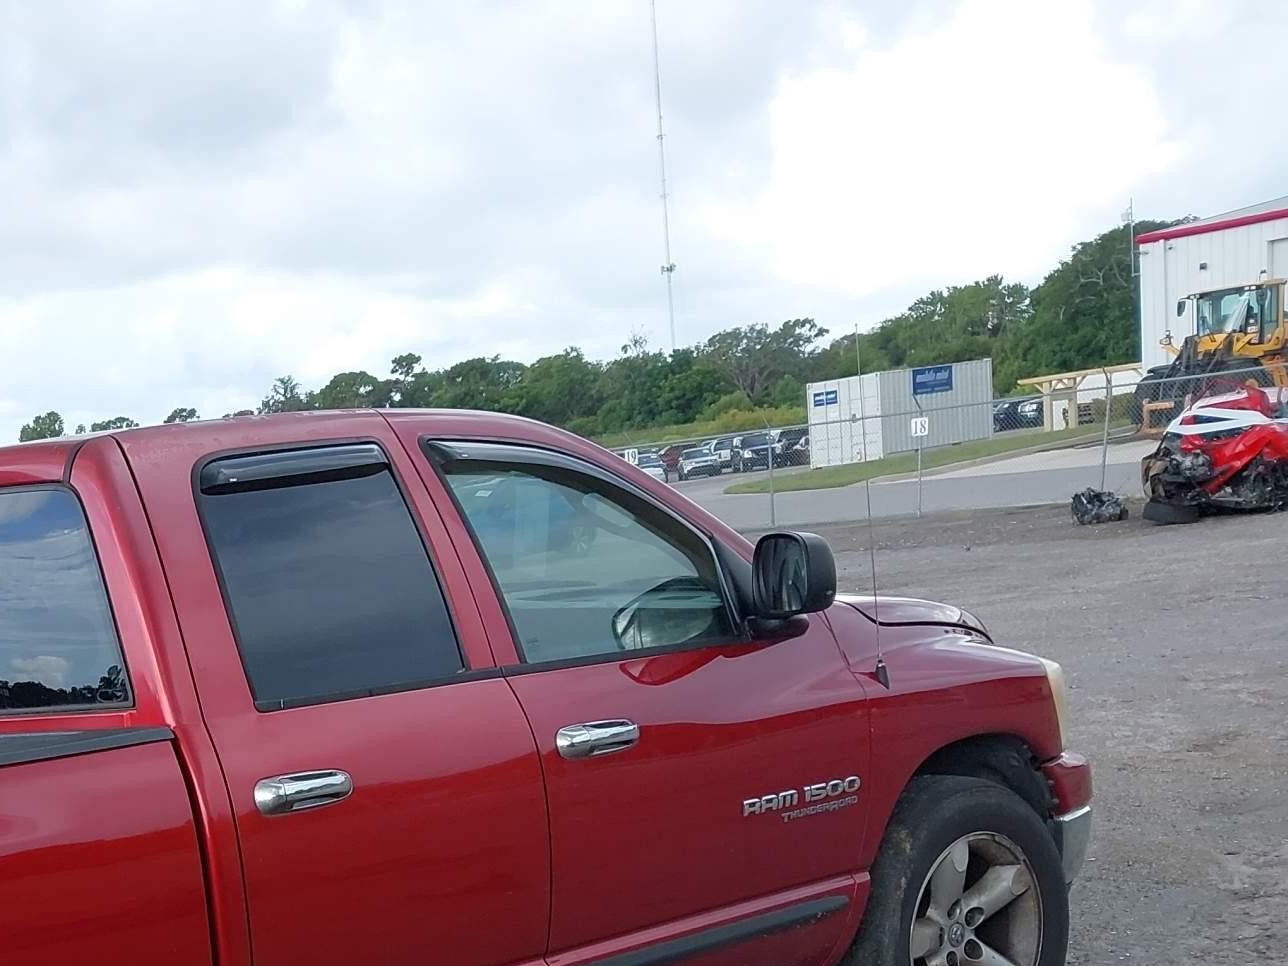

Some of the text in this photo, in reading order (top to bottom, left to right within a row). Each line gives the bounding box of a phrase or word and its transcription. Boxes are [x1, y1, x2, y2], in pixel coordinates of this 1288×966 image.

[914, 419, 927, 434] 18
[626, 450, 637, 464] 19
[742, 775, 861, 817] RAM 1500
